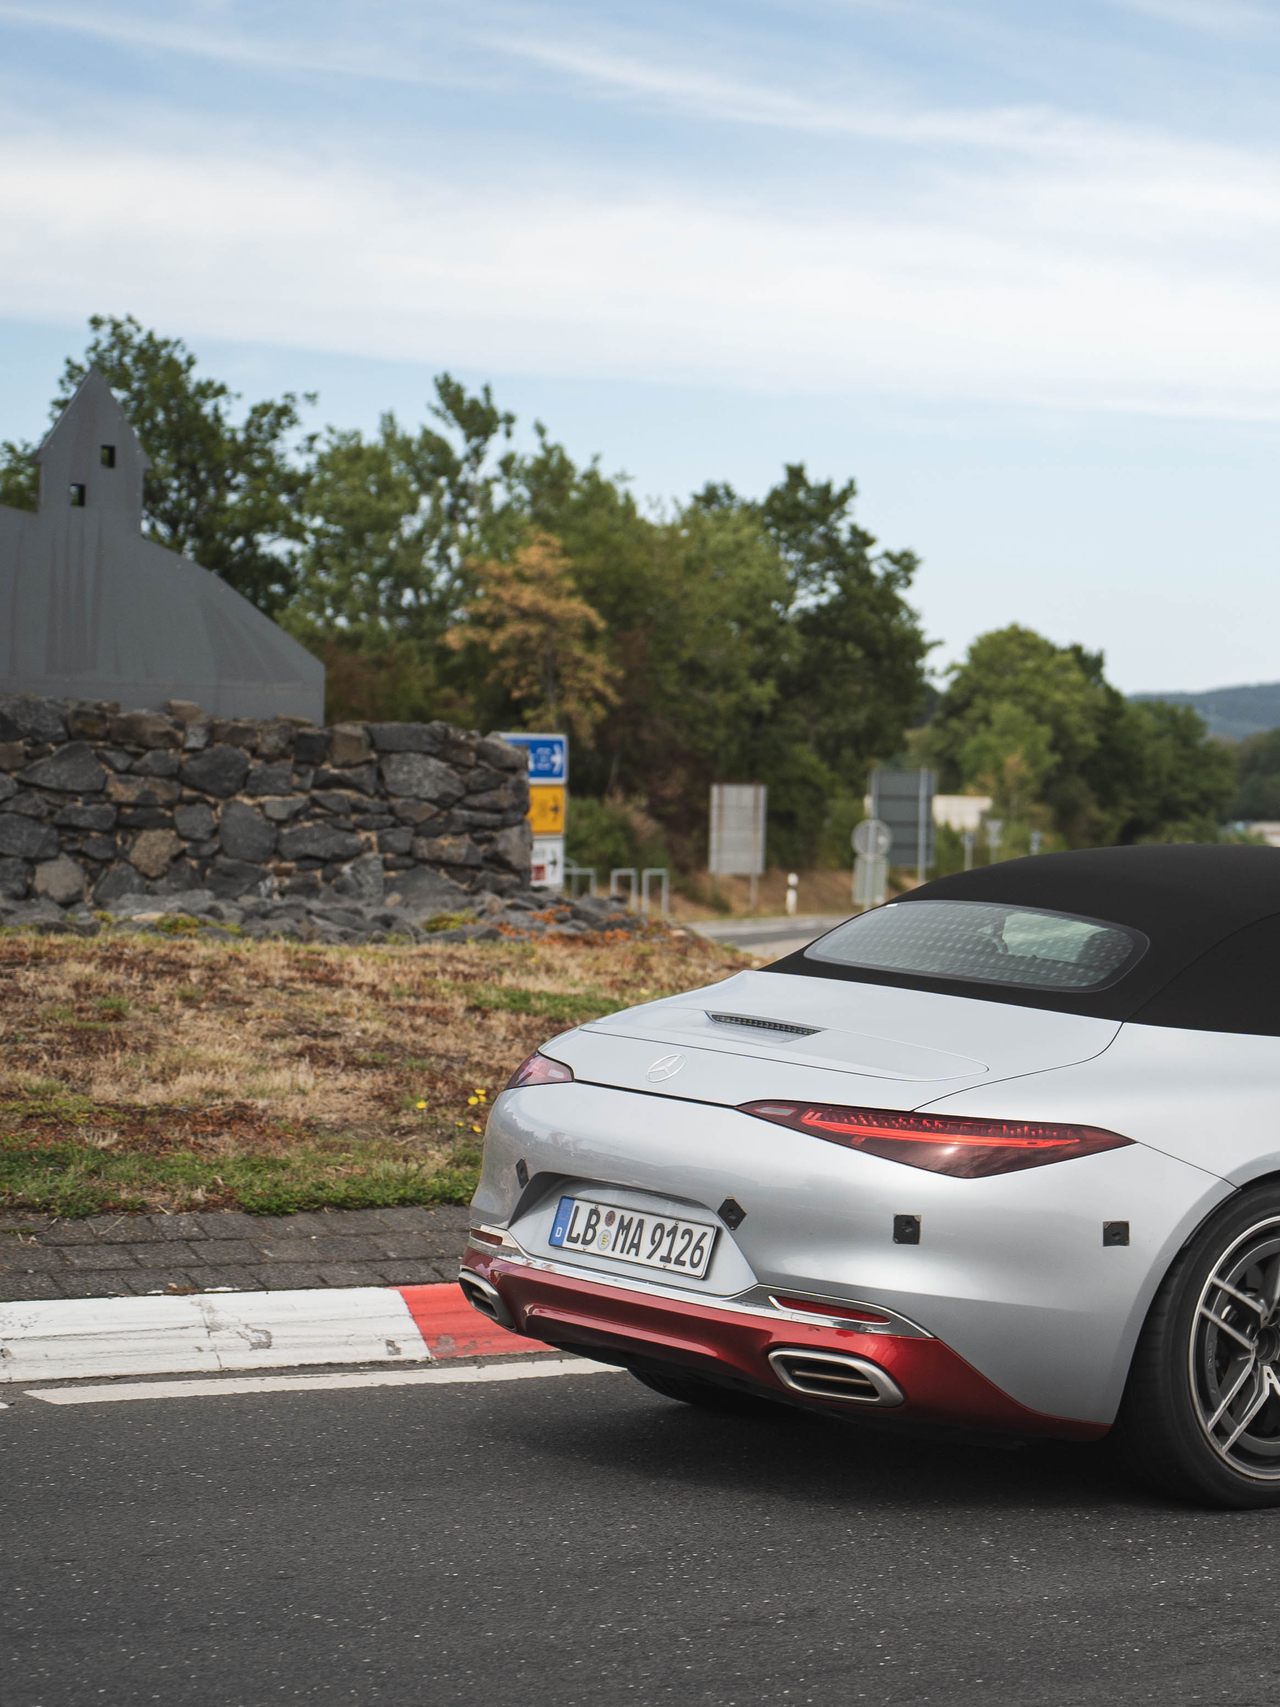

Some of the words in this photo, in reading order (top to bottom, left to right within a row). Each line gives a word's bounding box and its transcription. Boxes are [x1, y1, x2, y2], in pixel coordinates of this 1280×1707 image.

[555, 1226, 563, 1238] D
[566, 1205, 601, 1246] LB
[611, 1214, 645, 1257] MA
[646, 1222, 708, 1269] 9126
